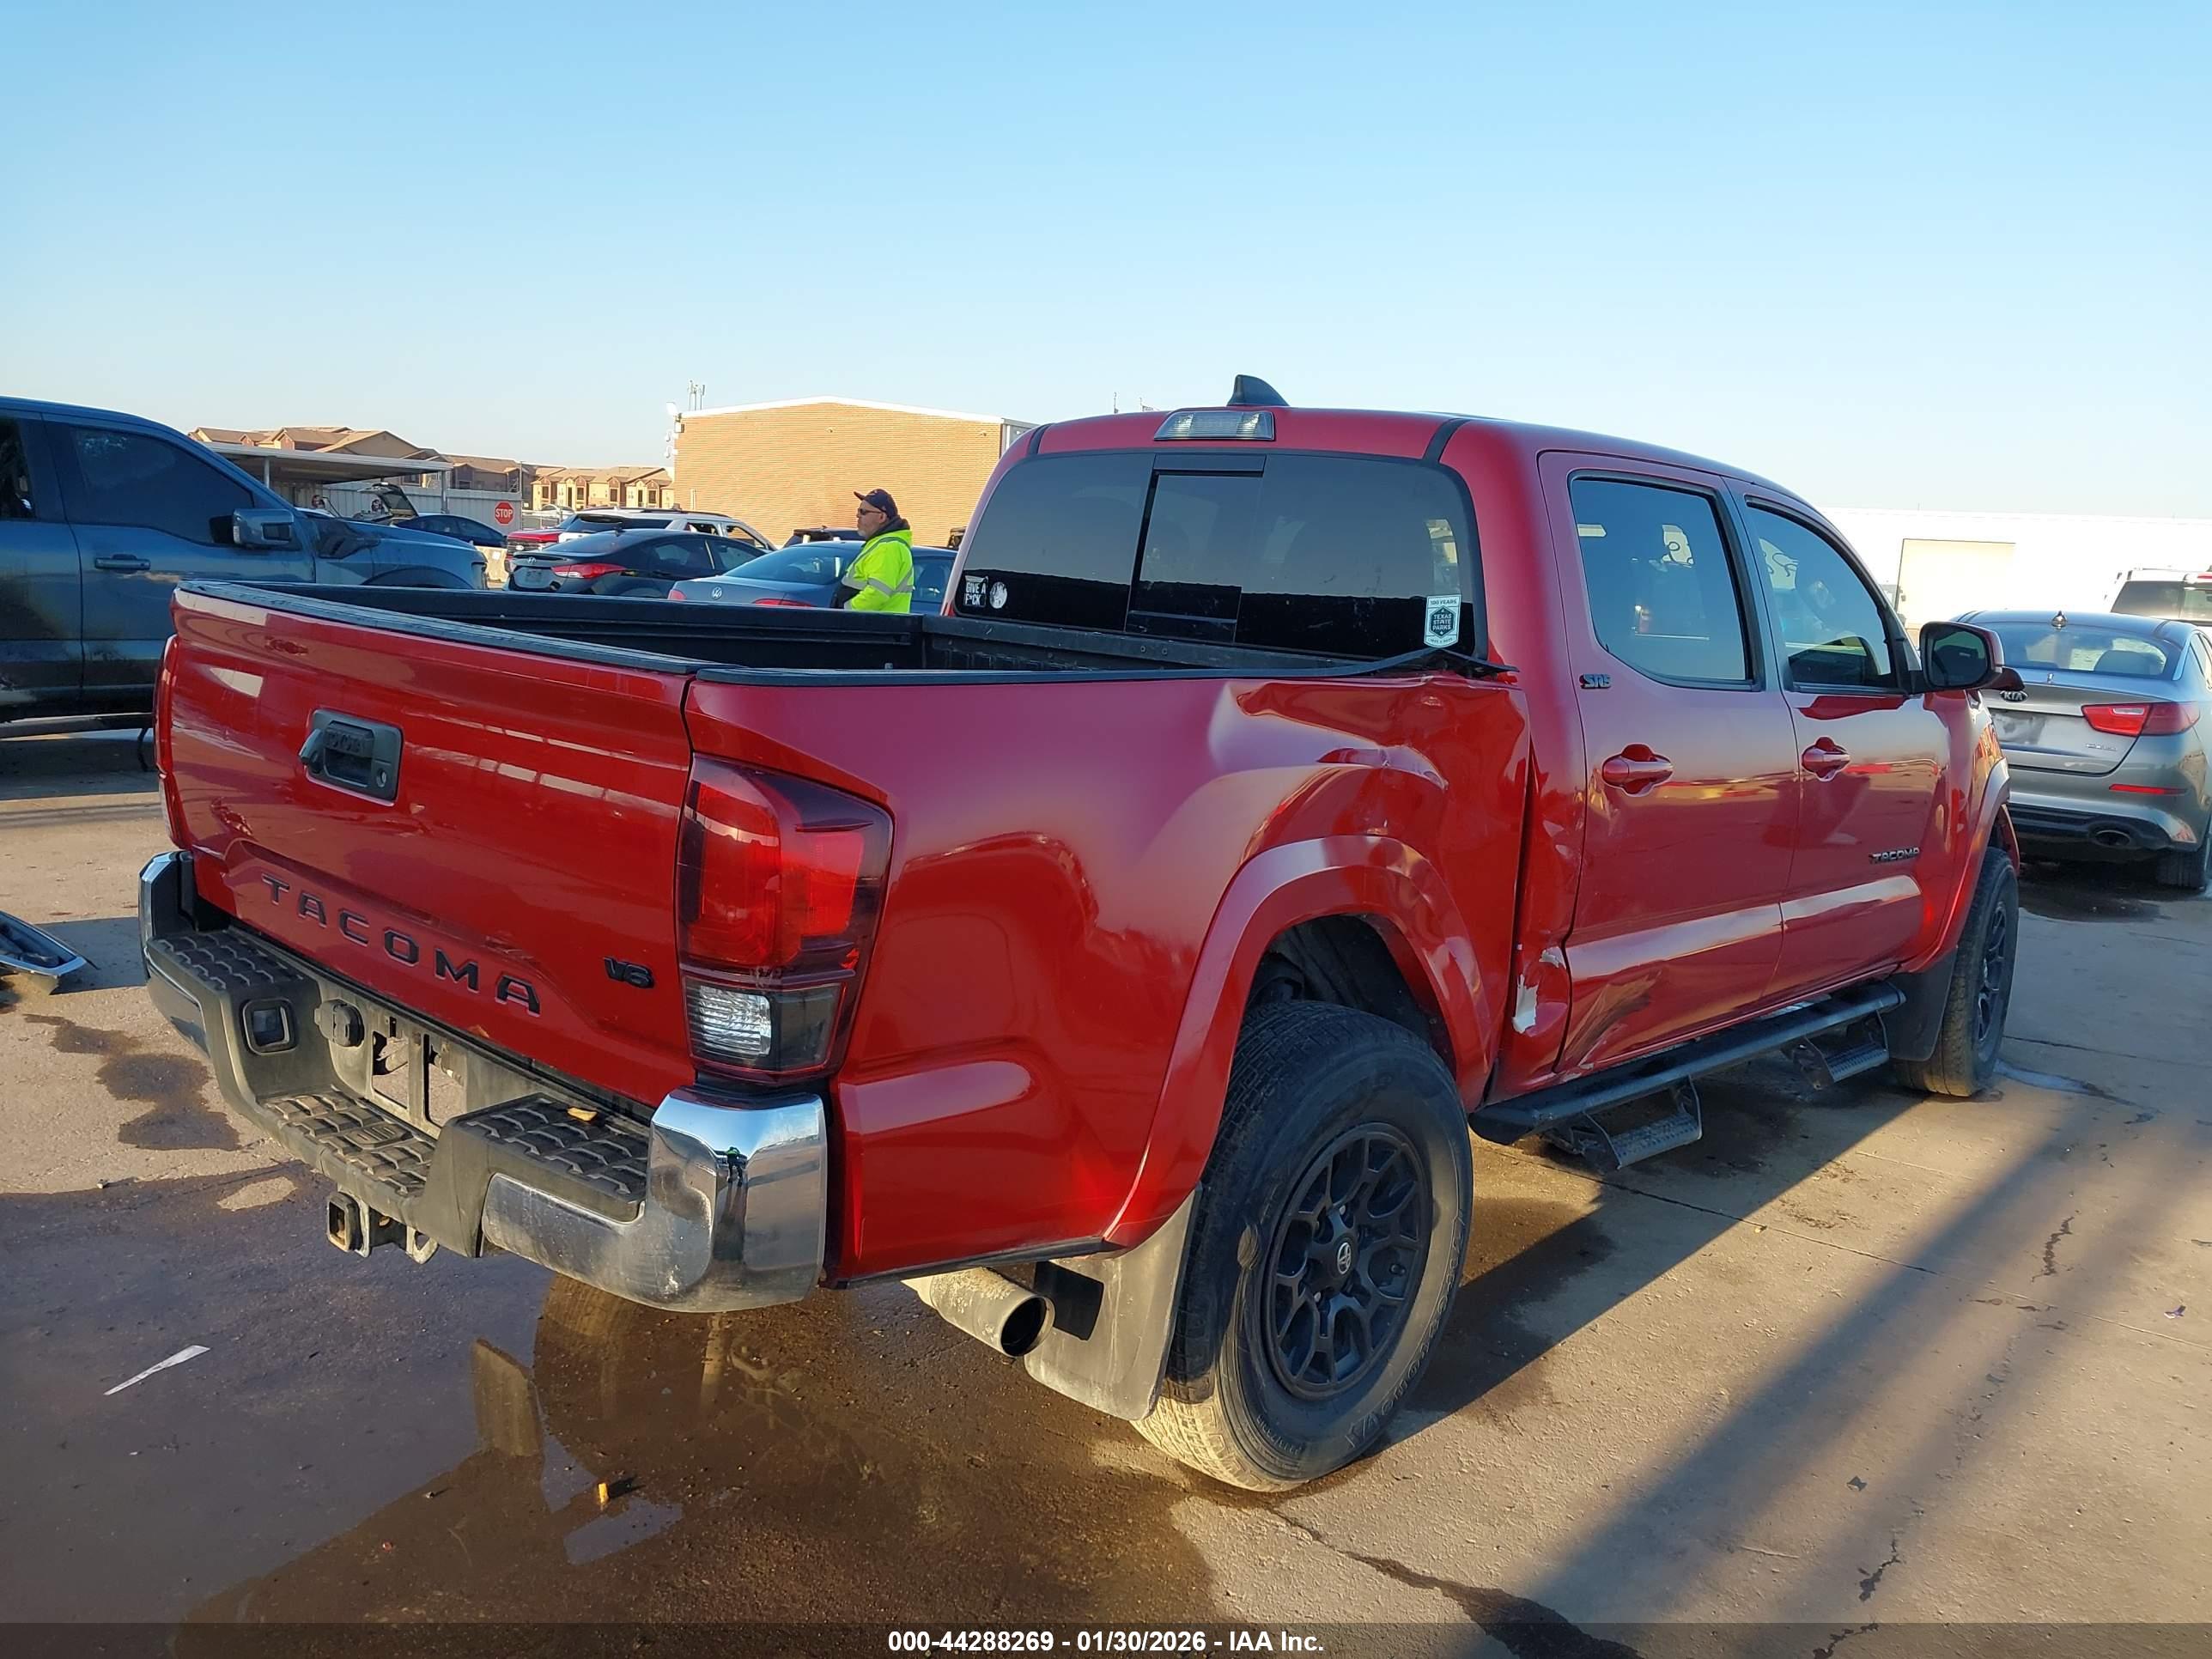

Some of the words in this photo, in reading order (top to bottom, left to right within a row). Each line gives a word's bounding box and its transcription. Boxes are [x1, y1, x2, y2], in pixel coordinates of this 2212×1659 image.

[495, 508, 514, 518] STOP
[965, 582, 980, 593] GIVE
[981, 582, 987, 593] A
[2003, 691, 2023, 701] KIA
[1869, 847, 1920, 864] TACOMA
[261, 873, 542, 1016] TACOMA
[603, 955, 655, 989] V6
